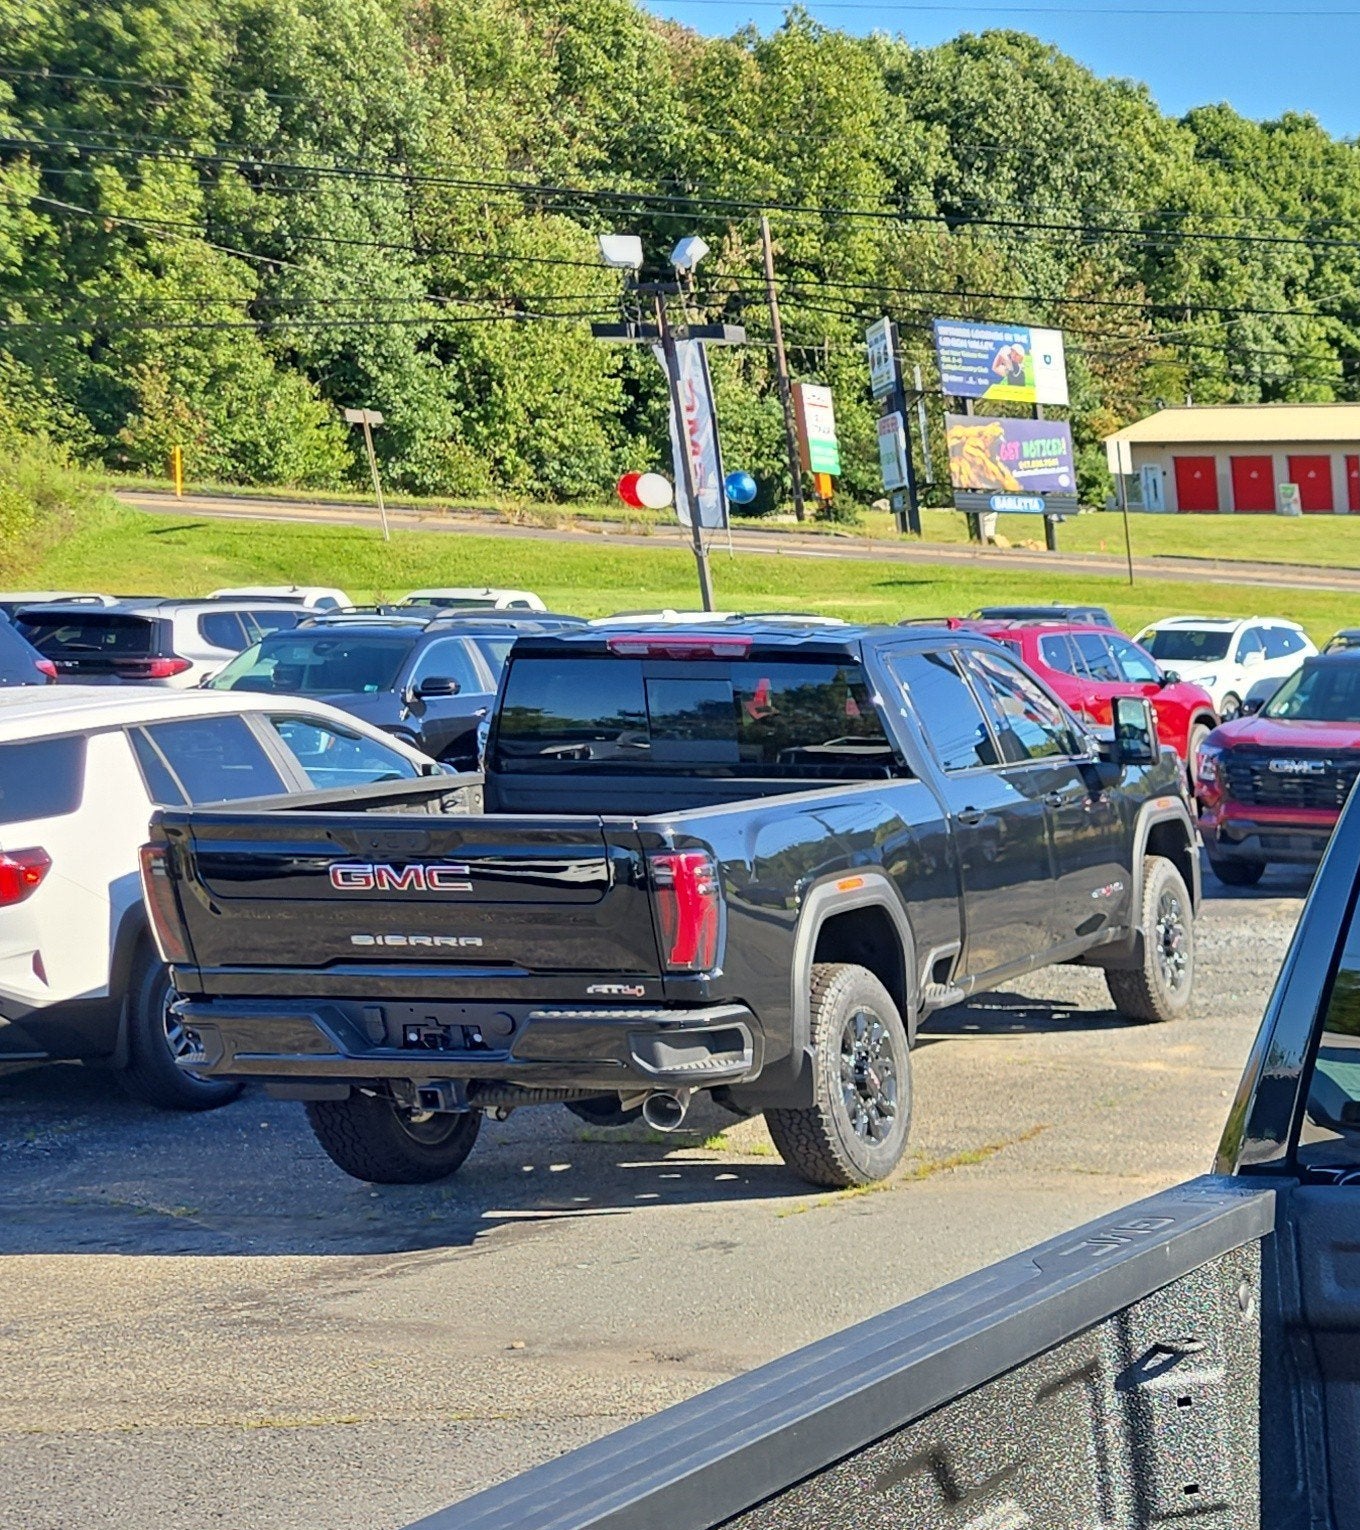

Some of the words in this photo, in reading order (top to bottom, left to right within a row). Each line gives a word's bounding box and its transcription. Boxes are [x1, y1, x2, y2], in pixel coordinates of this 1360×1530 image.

[1000, 441, 1019, 461] GET
[1022, 437, 1067, 458] NOTICED!
[1268, 759, 1326, 775] GMC
[329, 864, 473, 892] GMC
[350, 935, 483, 946] SIERRA
